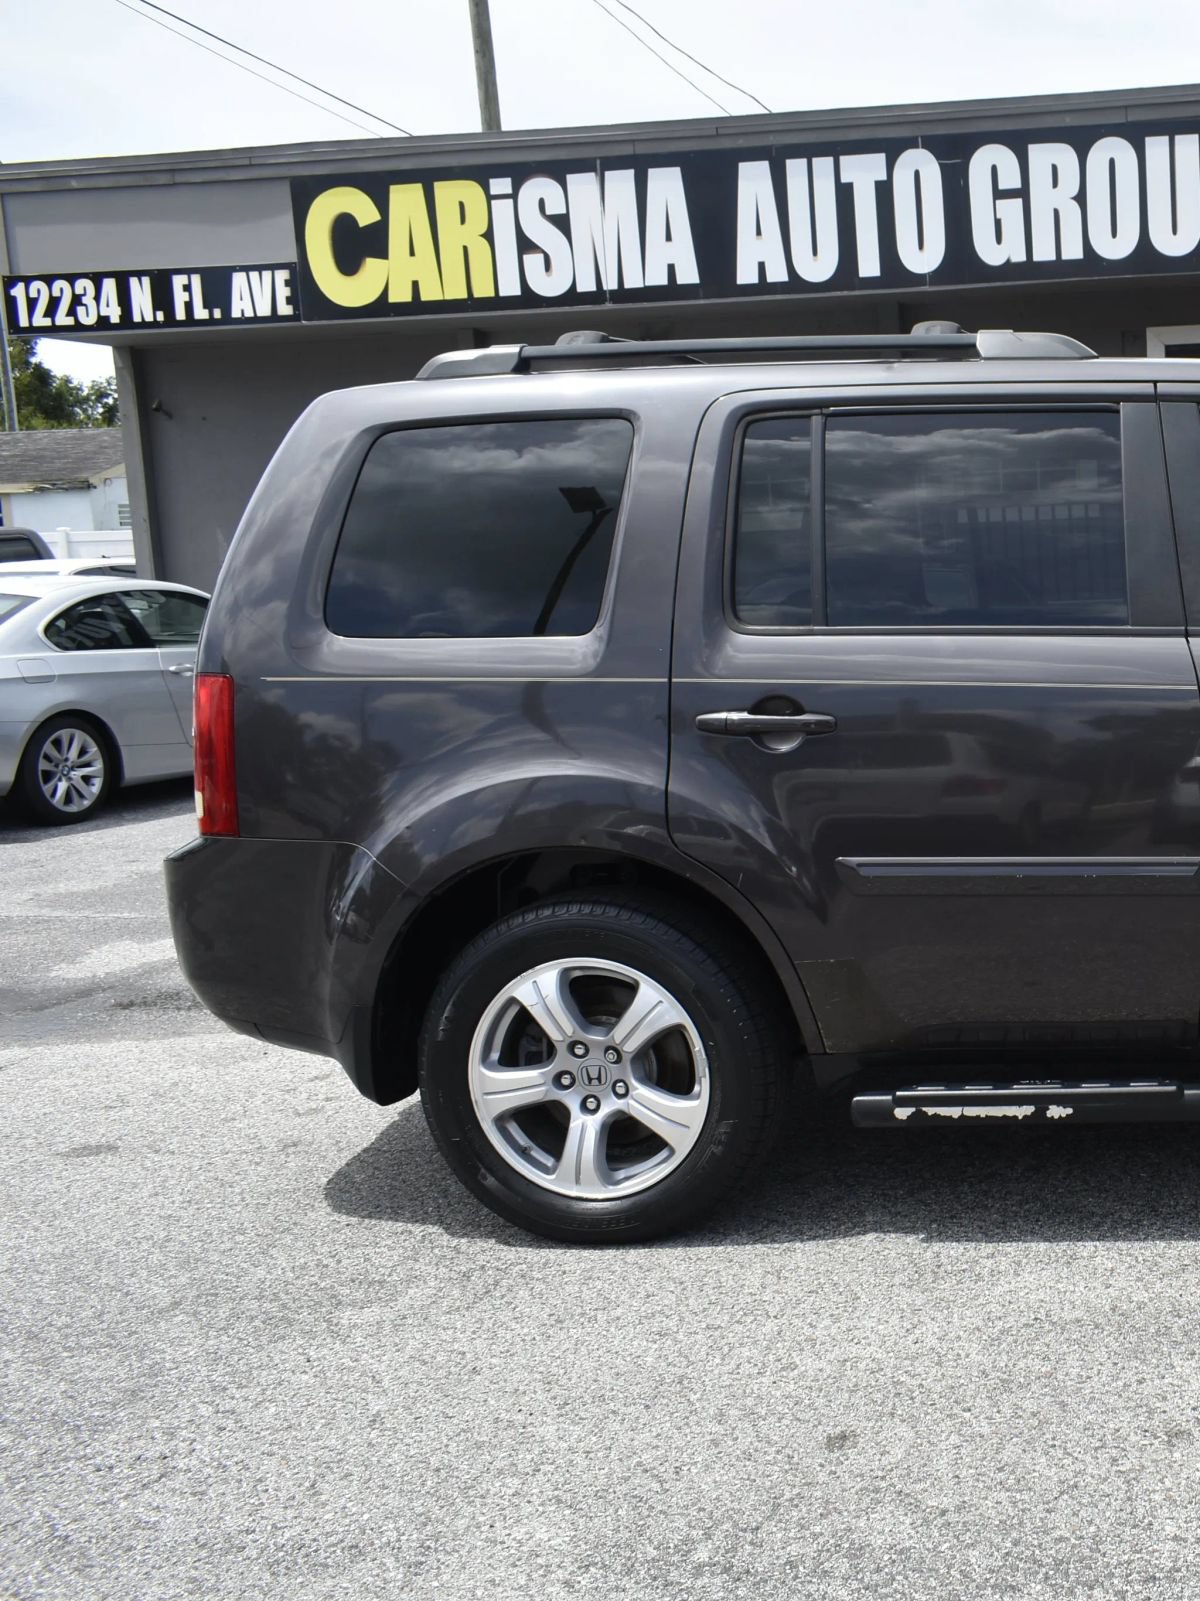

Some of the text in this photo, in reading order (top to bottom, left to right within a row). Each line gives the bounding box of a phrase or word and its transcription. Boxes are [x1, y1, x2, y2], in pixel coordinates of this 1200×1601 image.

[736, 148, 946, 285] AUTO
[9, 269, 294, 328] 12234 N. FL. AVE
